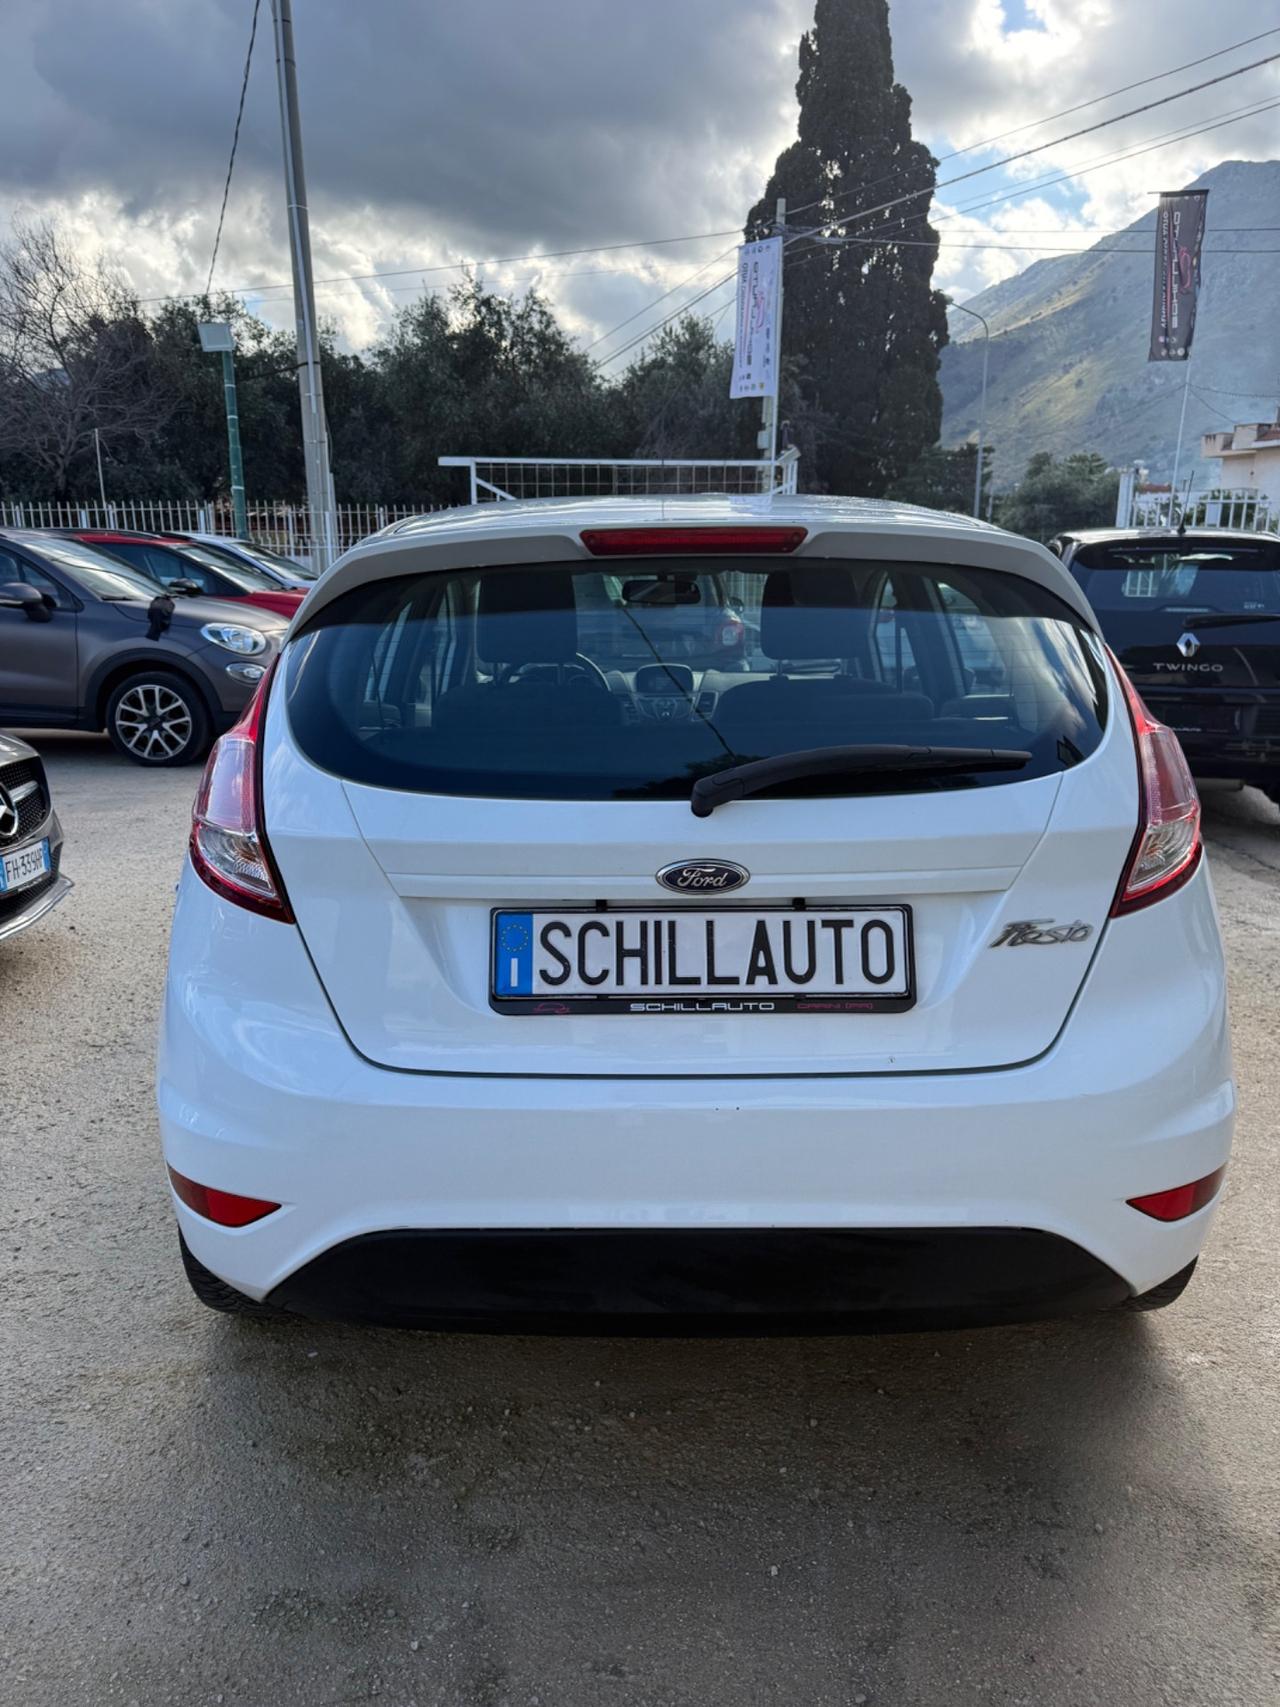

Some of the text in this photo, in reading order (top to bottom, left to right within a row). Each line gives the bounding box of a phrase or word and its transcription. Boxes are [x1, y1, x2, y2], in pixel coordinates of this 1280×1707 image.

[1153, 662, 1223, 673] TWINGO
[676, 867, 729, 887] Ford
[988, 917, 1093, 948] Fiesta
[538, 919, 894, 986] SCHILLAUTO
[630, 1002, 775, 1012] SCHILLAUTO
